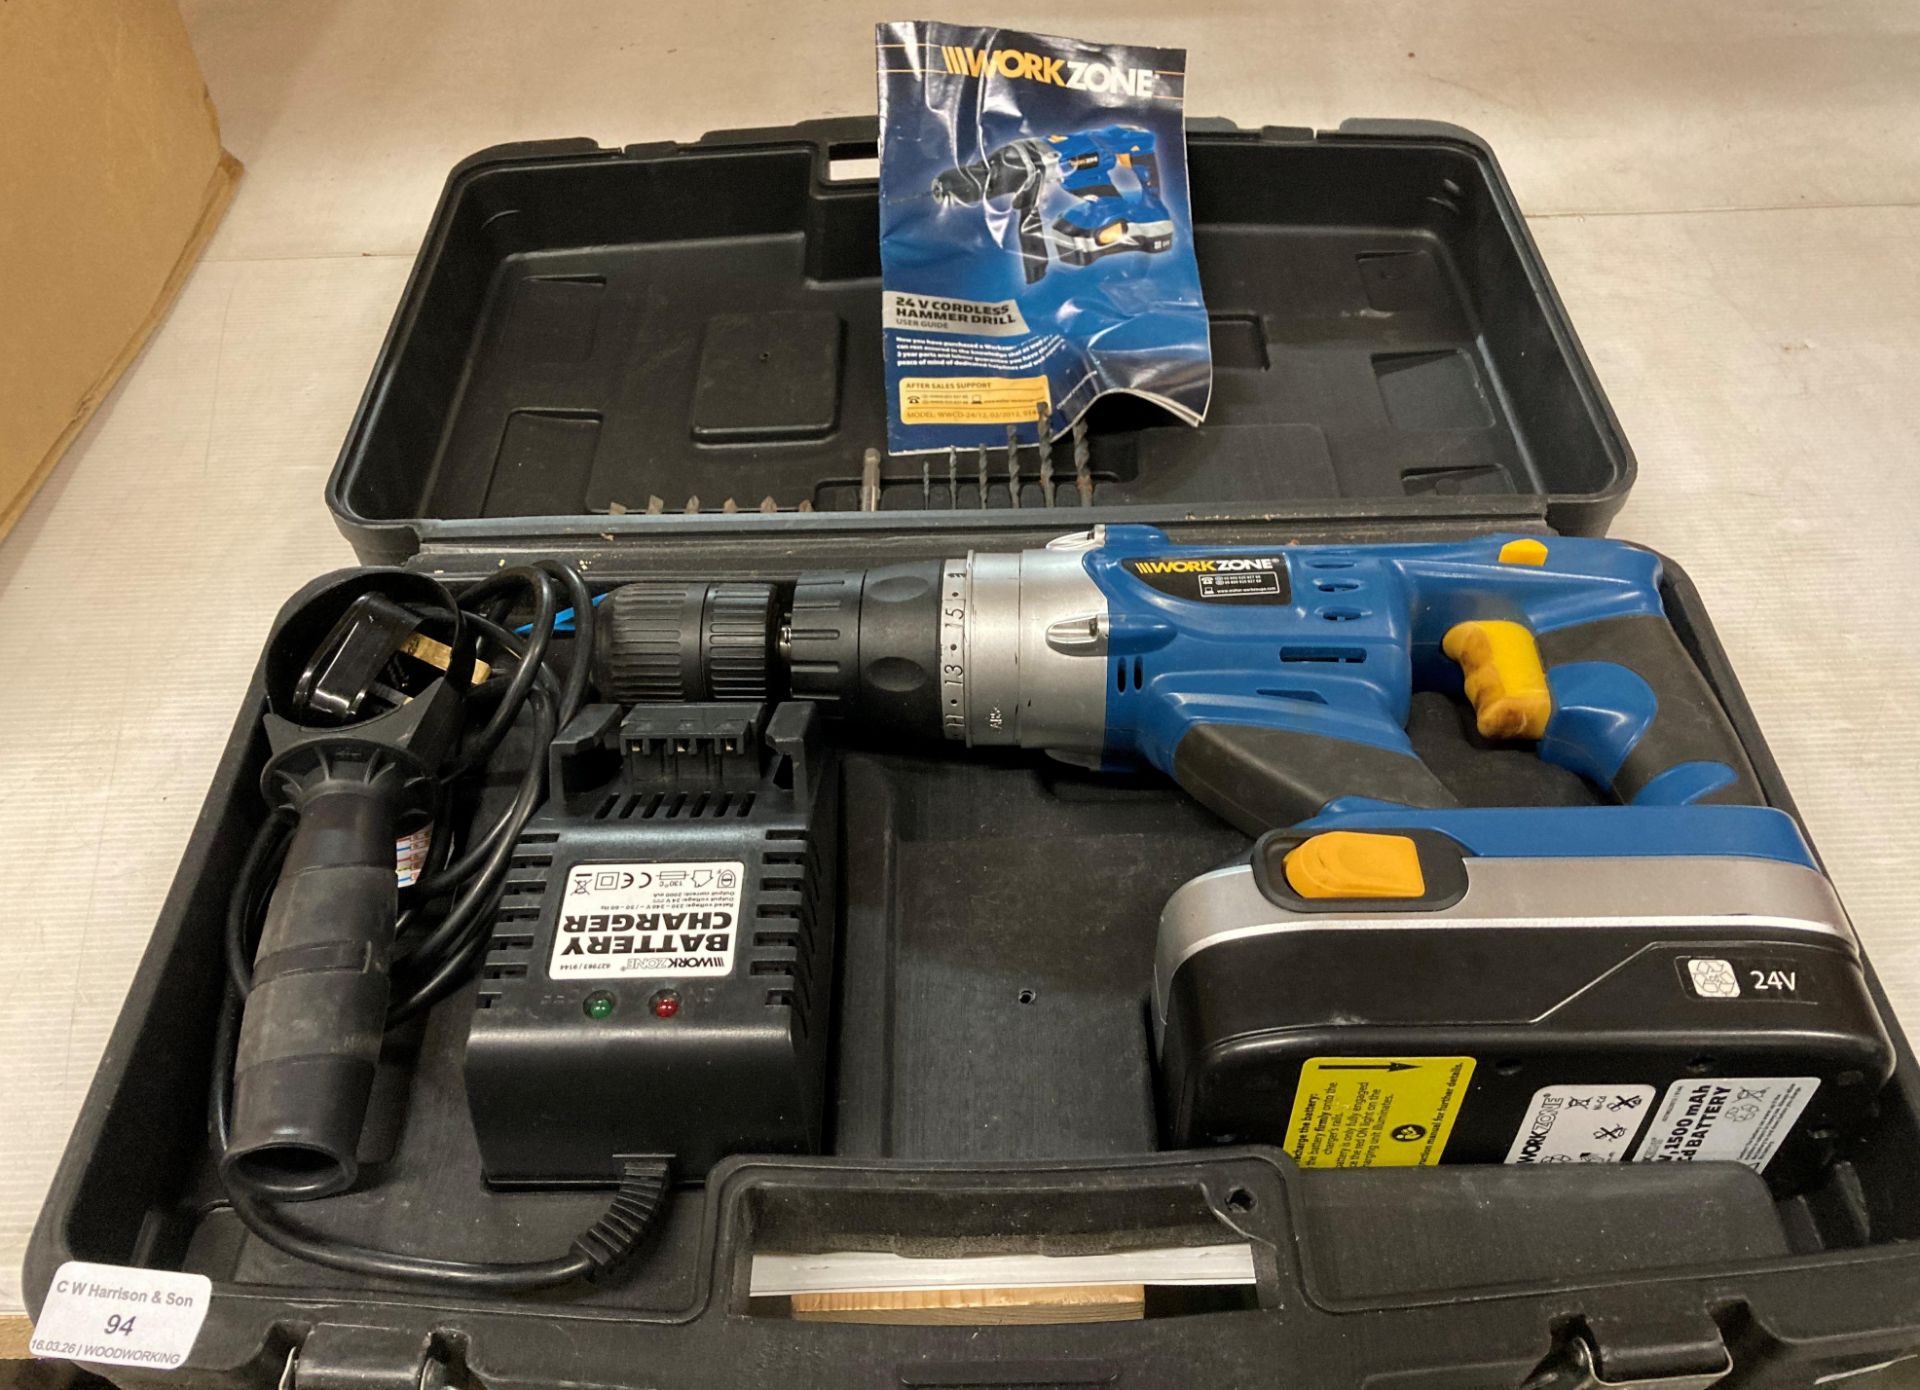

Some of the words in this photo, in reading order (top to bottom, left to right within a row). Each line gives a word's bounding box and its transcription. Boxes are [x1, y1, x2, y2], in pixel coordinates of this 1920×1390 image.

[896, 297, 915, 306] 24
[918, 300, 929, 309] V
[931, 301, 1009, 315] CORDLESS
[896, 308, 967, 322] HAMMER
[971, 314, 1016, 325] DRILL
[896, 319, 919, 327] USER
[921, 321, 948, 329] GUIDE
[945, 608, 964, 626] 15
[944, 664, 963, 684] 13
[563, 912, 732, 933] CHARGER
[560, 934, 729, 955] BATTERY
[1750, 970, 1795, 991] 24V
[1353, 1082, 1370, 1111] engaged
[1315, 1112, 1330, 1131] firmly
[1426, 1122, 1440, 1144] manual
[1438, 1088, 1453, 1110] further
[1664, 1118, 1692, 1150] 1500
[1686, 1085, 1712, 1116] mAh
[1689, 1086, 1732, 1147] BATTERY
[1300, 1122, 1310, 1132] the
[1310, 1132, 1324, 1154] battery
[57, 1281, 68, 1293] C
[71, 1282, 87, 1295] W
[88, 1284, 148, 1303] Harrison
[151, 1291, 162, 1304] &
[166, 1293, 194, 1307] Son
[104, 1314, 136, 1336] 94
[31, 1339, 76, 1353] 16.03.26
[84, 1345, 181, 1364] WOODWORKING
